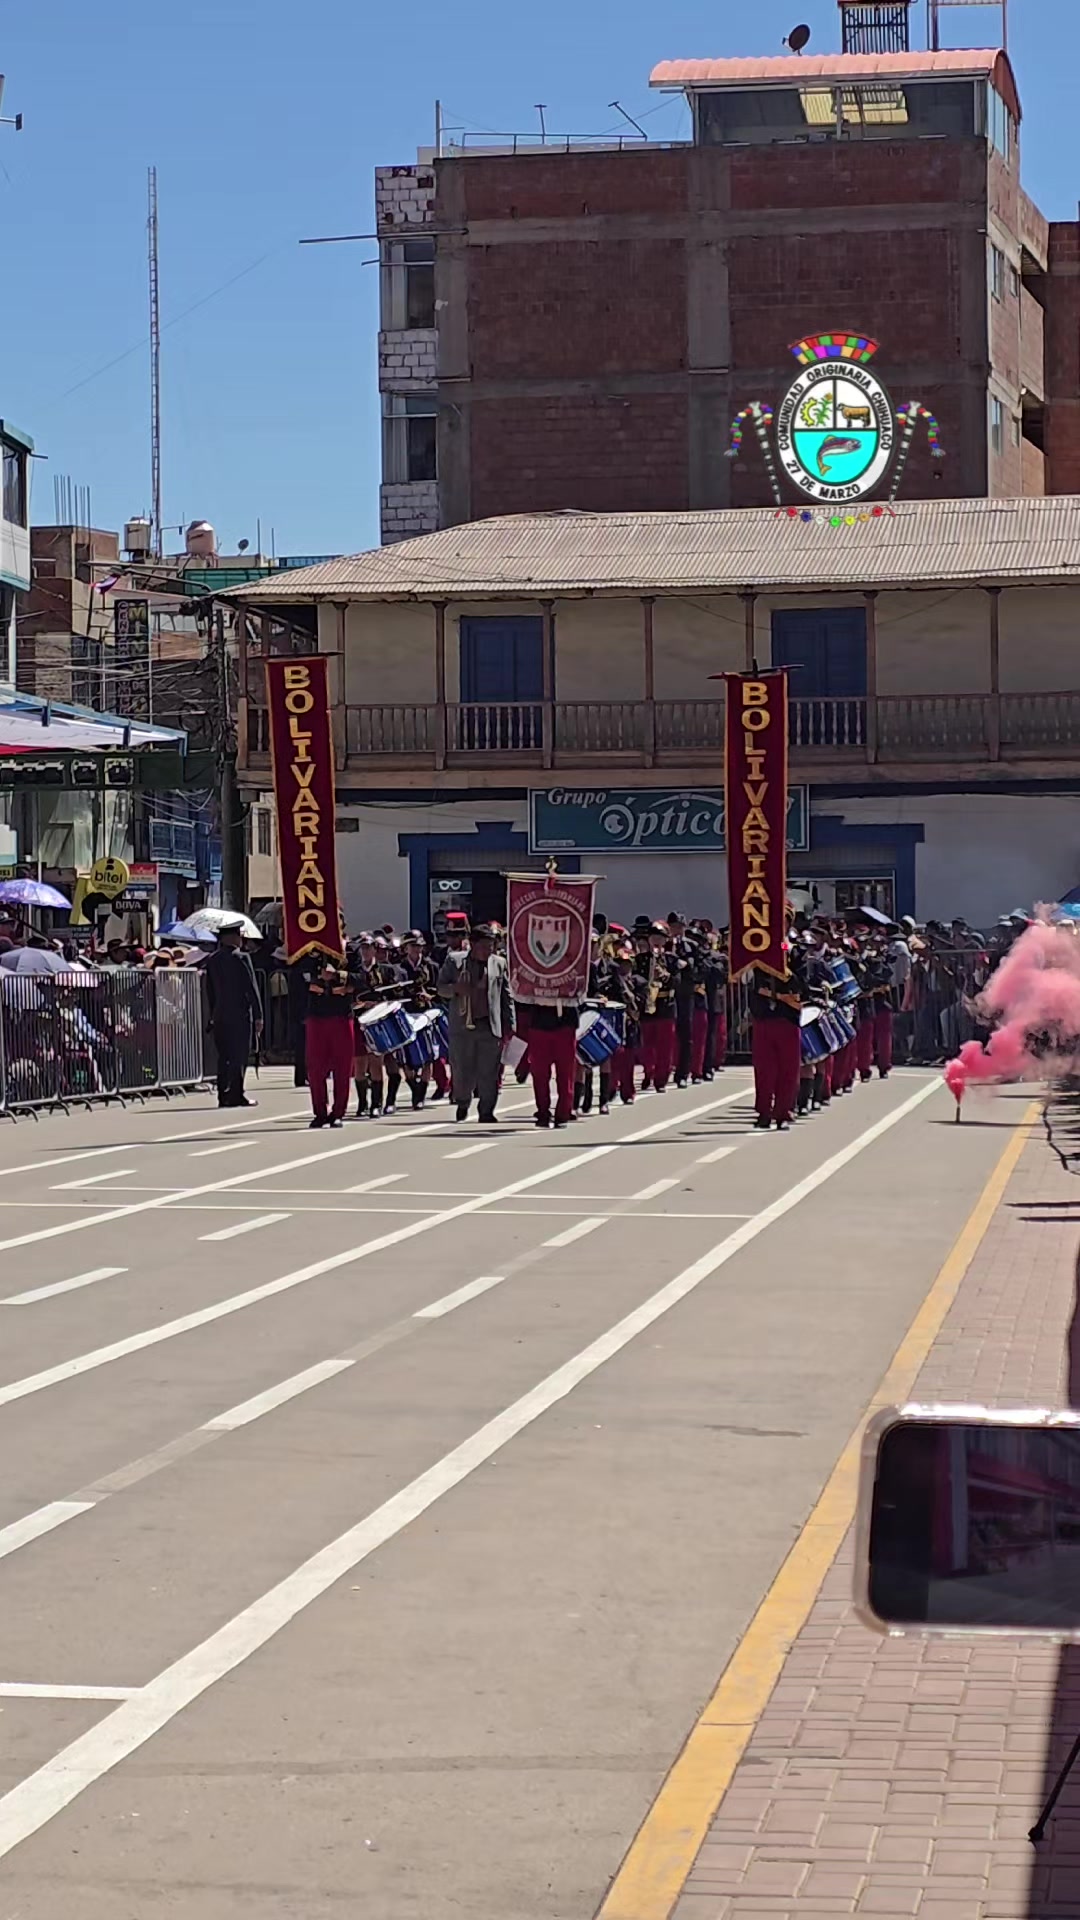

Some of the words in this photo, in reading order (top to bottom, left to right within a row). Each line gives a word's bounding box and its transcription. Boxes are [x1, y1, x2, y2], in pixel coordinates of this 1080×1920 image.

[284, 665, 327, 933] BOLIVARIANO
[547, 787, 607, 808] Grupo
[741, 681, 771, 953] BOLIVARIANO
